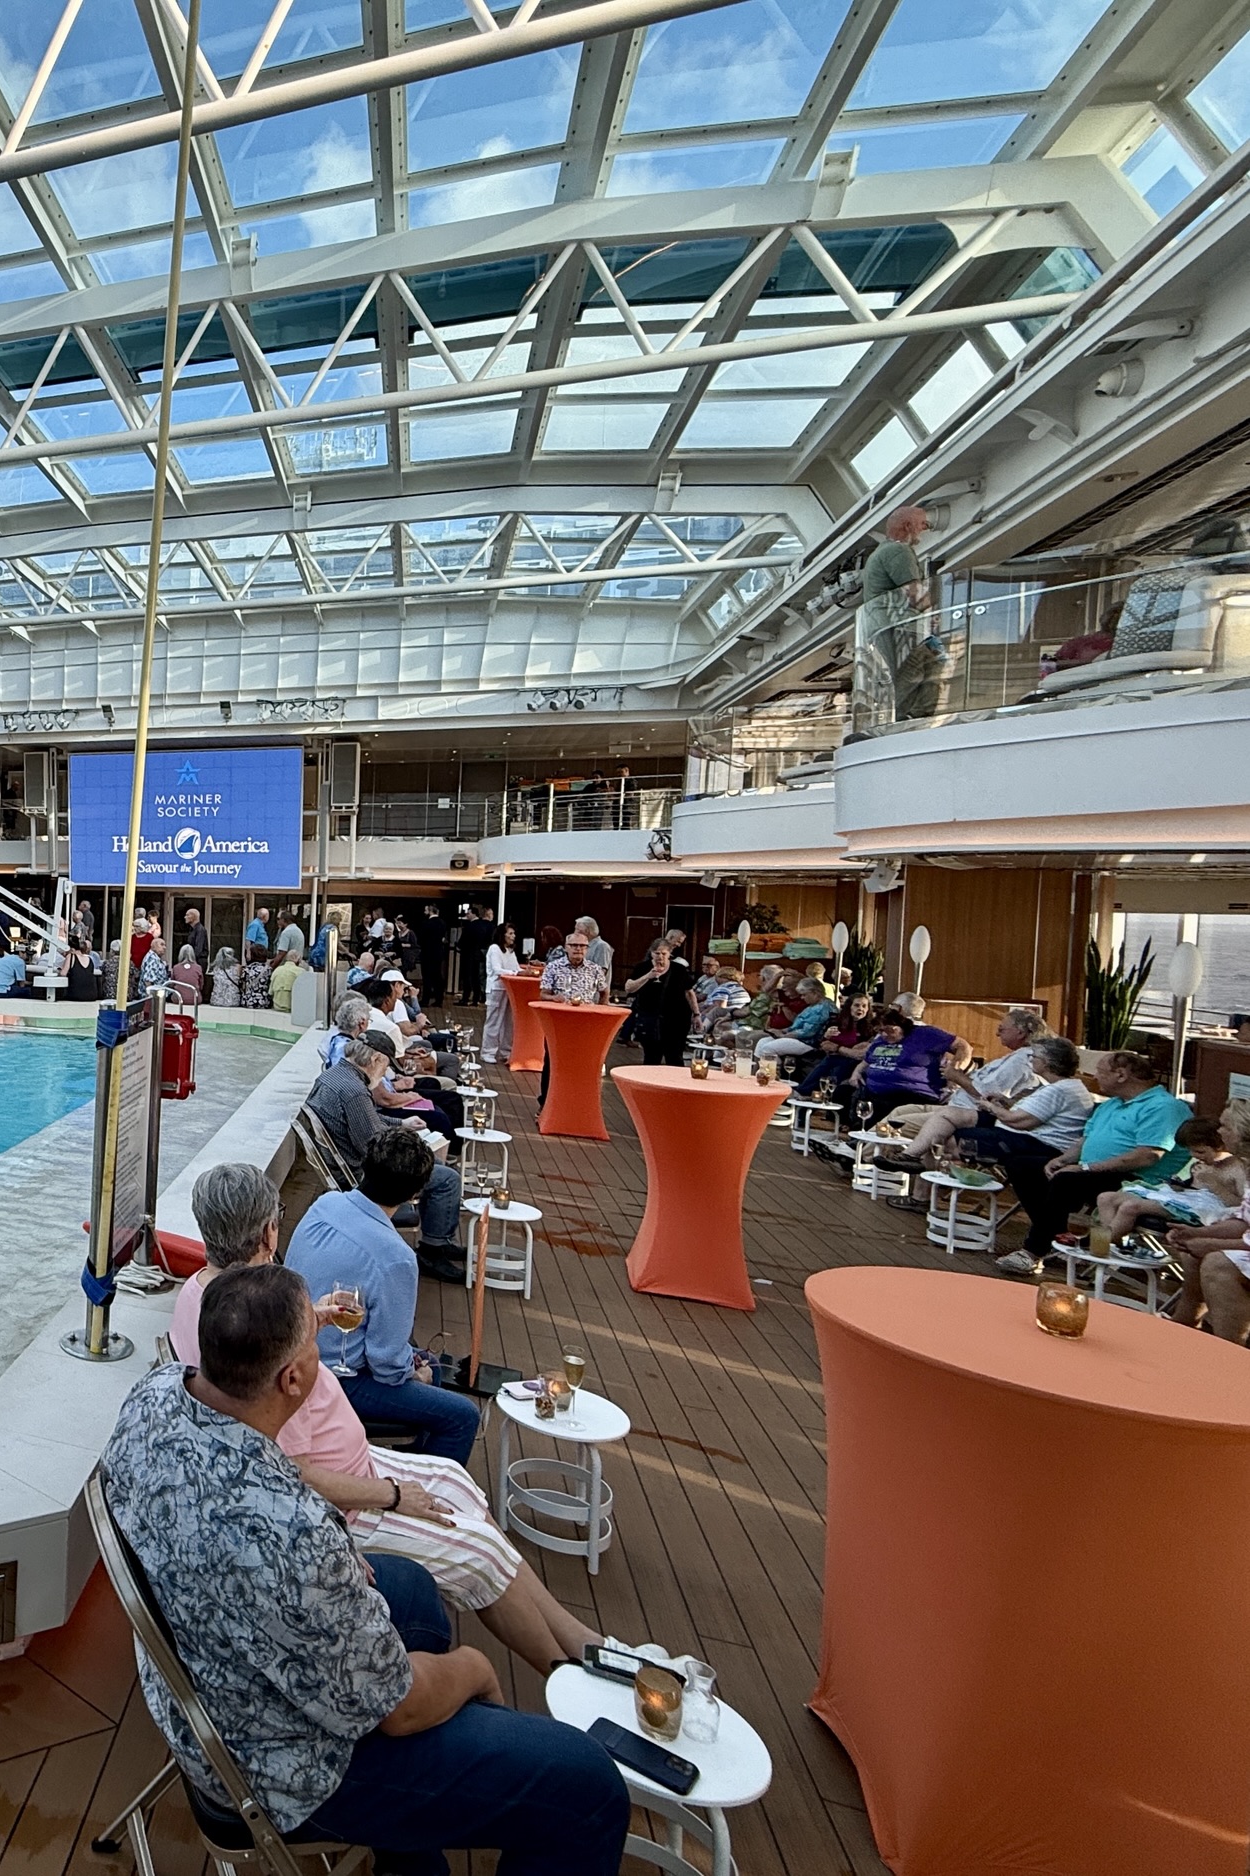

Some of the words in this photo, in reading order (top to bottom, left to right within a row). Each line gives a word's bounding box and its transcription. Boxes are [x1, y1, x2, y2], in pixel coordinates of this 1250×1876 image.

[154, 793, 222, 805] MARINER
[157, 806, 220, 817] SOCIETY
[112, 835, 174, 853] Hland
[201, 834, 270, 853] America
[137, 859, 179, 874] Savour
[180, 863, 193, 873] the
[193, 860, 242, 878] Journey
